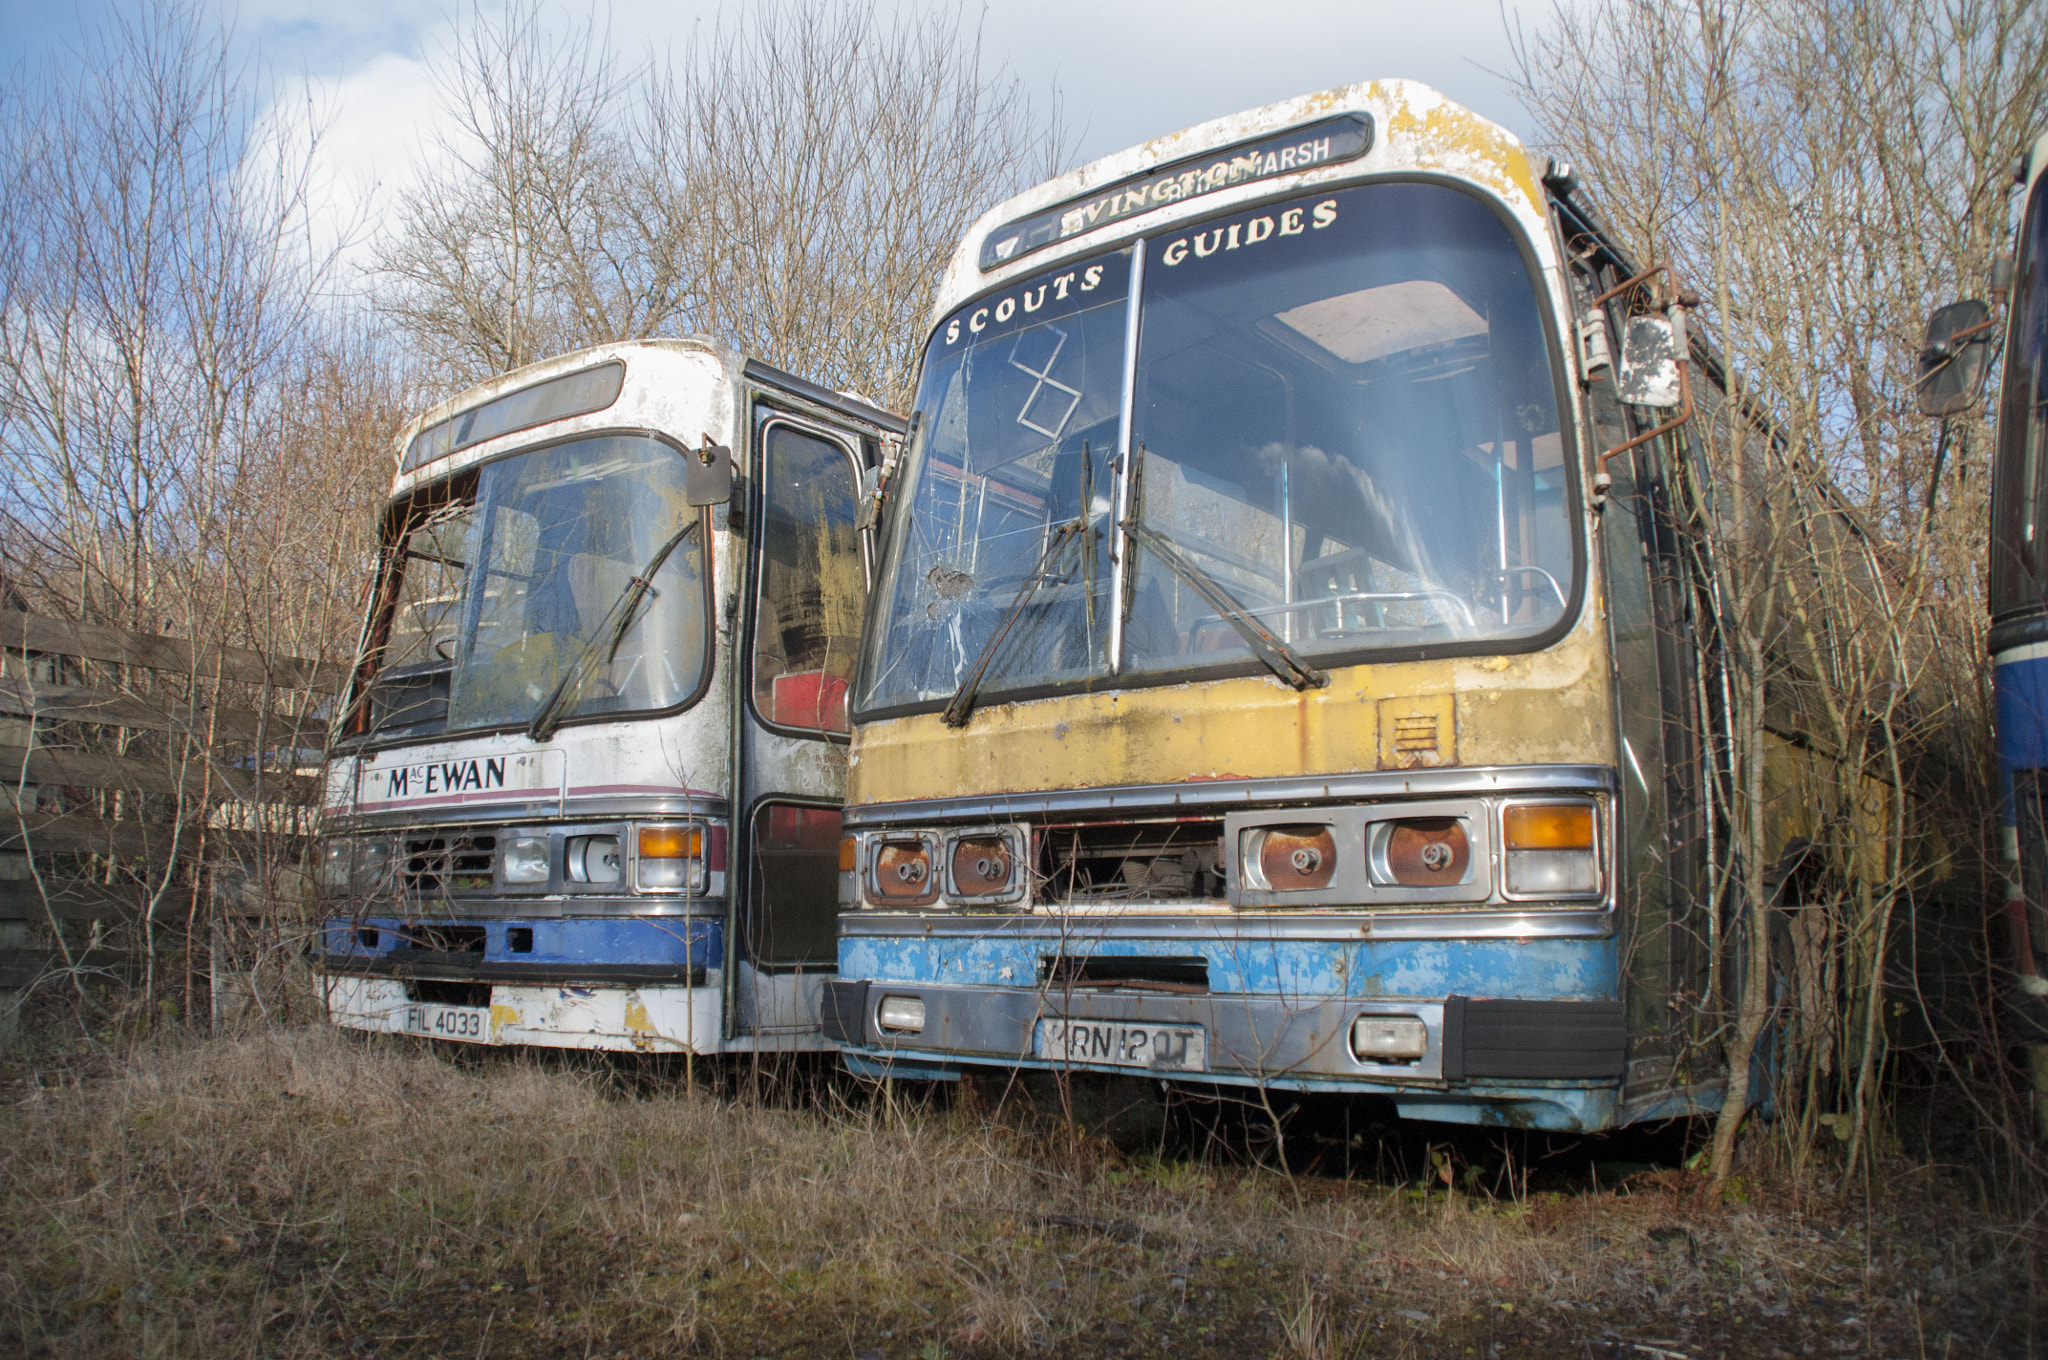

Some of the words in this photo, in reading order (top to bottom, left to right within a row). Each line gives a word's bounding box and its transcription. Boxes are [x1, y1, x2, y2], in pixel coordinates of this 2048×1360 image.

[945, 265, 1104, 345] SCOUTS
[1163, 199, 1337, 266] GUIDES
[436, 1011, 480, 1036] 4033
